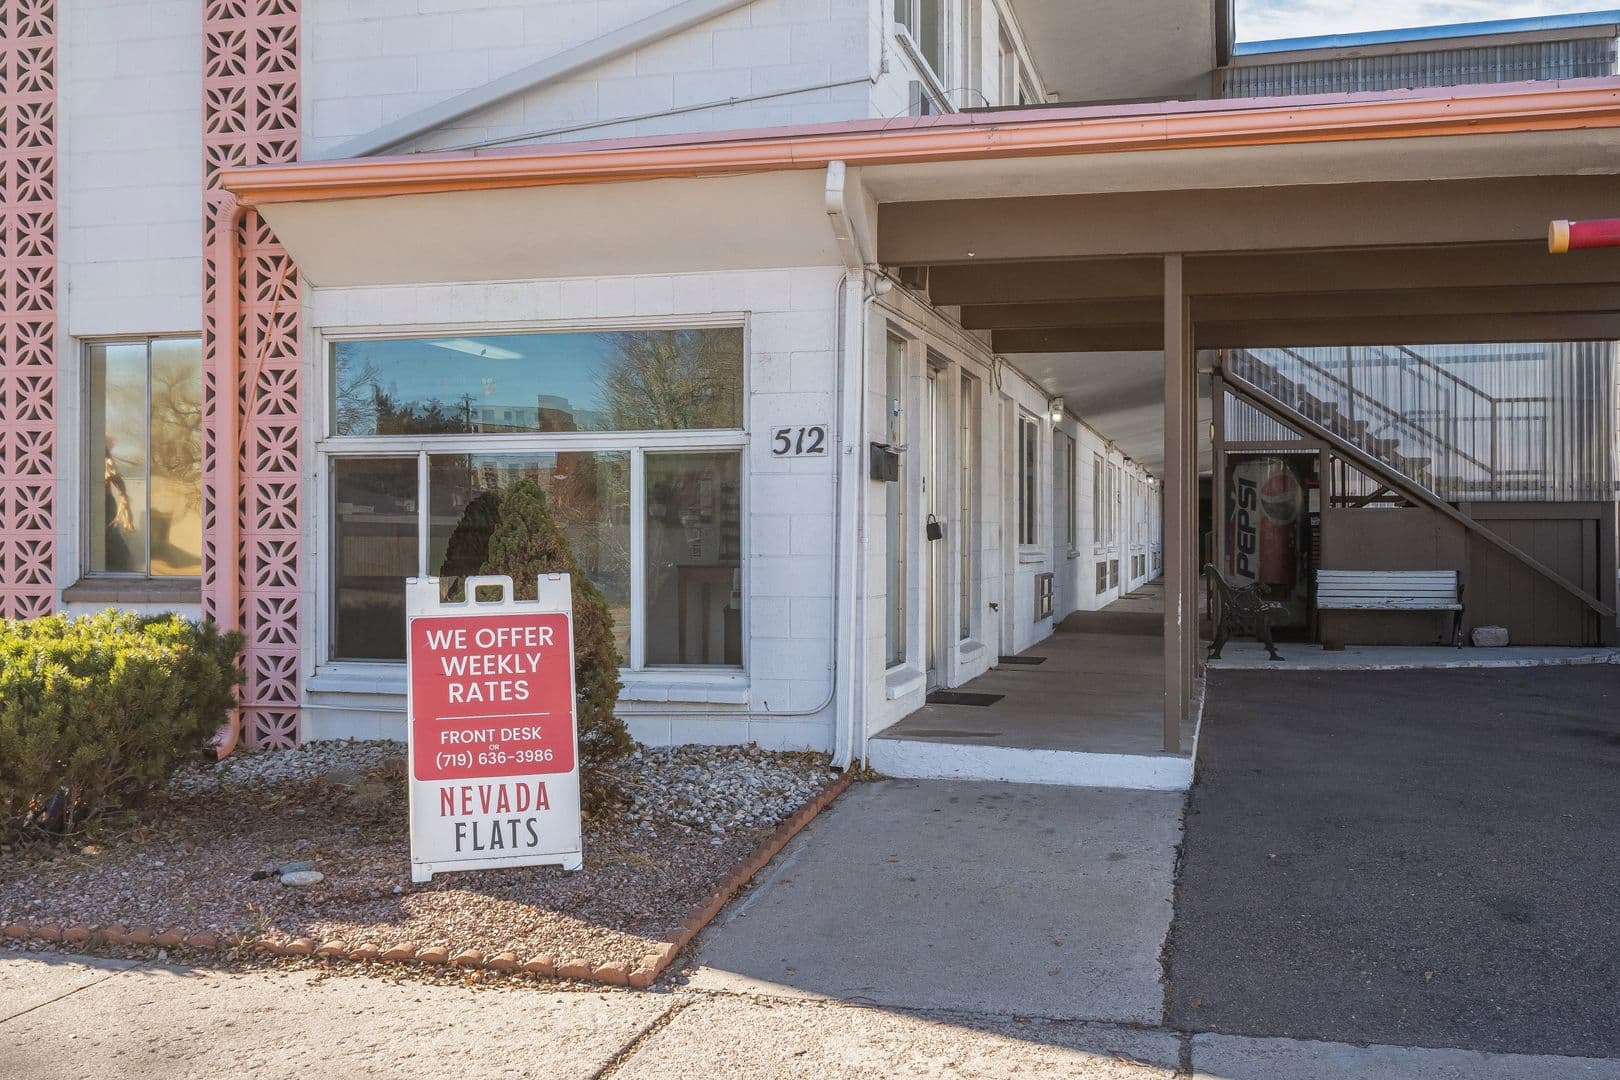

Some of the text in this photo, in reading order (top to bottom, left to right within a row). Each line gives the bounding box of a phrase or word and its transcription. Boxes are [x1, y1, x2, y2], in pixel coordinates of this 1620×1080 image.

[773, 426, 824, 455] 512
[1236, 477, 1257, 579] PEPSI
[426, 626, 554, 650] WE OFFER
[441, 653, 542, 677] WEEKLY
[448, 680, 530, 704] RATES
[440, 727, 542, 744] FRONT DESK
[436, 749, 553, 770] (719) 636-3986
[440, 781, 550, 817] NEVADA
[454, 818, 539, 852] FLATS
